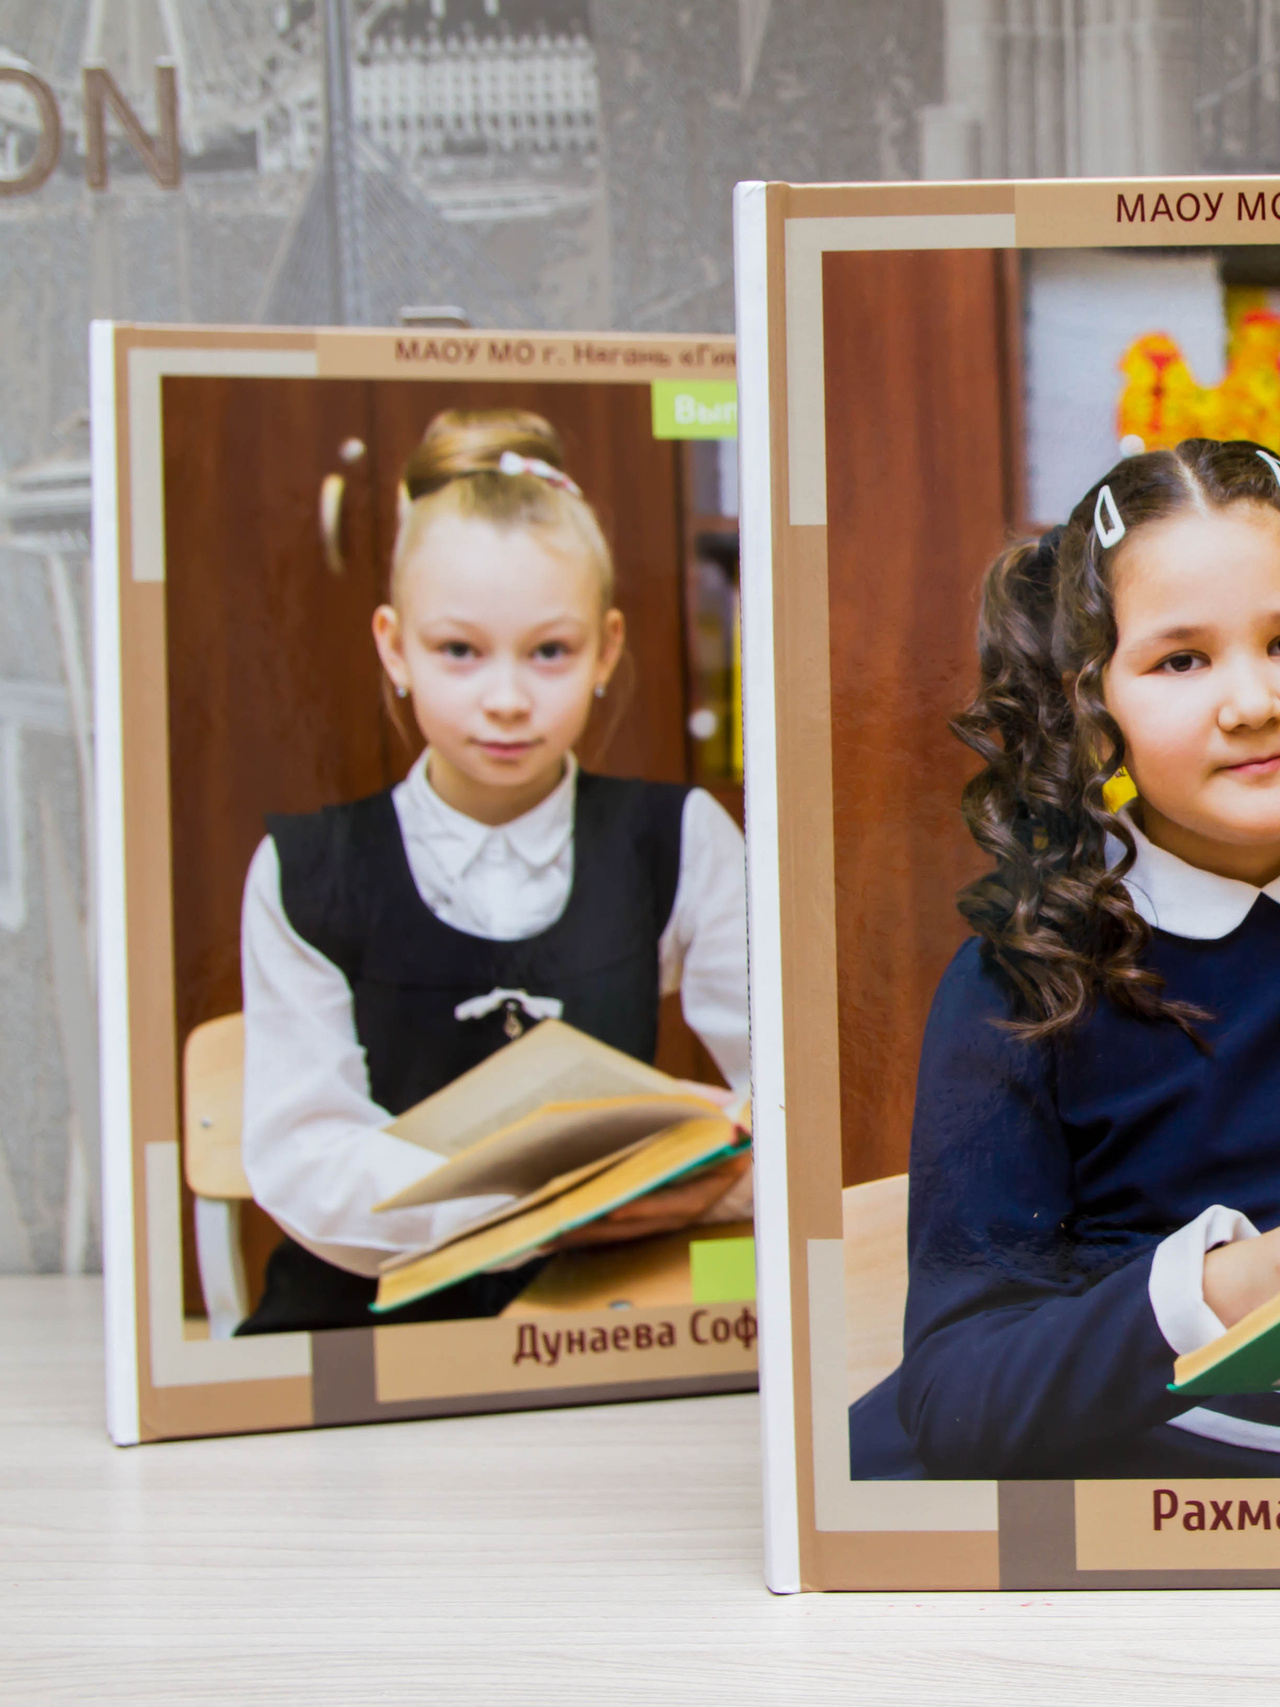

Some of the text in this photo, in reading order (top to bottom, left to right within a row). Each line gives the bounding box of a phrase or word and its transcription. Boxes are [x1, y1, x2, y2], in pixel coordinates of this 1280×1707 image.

[1115, 191, 1224, 223] МАОУ
[394, 339, 480, 365] МАОУ
[487, 339, 536, 366] МО
[512, 1321, 677, 1368] Дунаева
